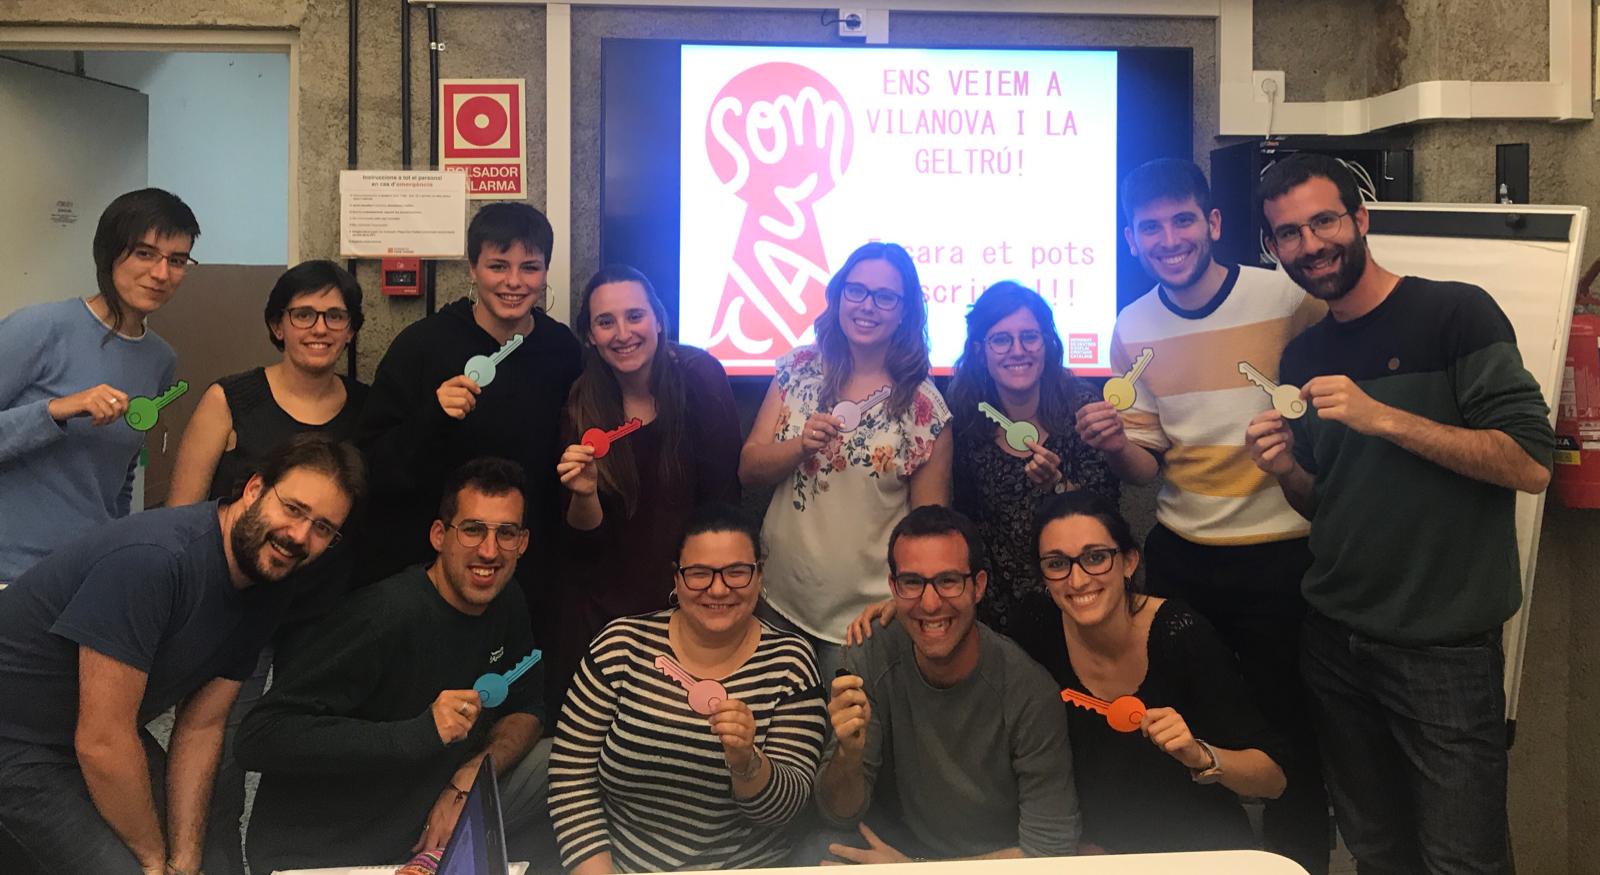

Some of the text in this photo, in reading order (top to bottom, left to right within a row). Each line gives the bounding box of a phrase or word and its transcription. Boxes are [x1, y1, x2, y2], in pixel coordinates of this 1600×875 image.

[883, 69, 1062, 96] ENS VEIEM A
[866, 109, 1078, 136] VILANOVA I LA
[915, 146, 1023, 176] GELTRÚ!
[982, 241, 1013, 265] et
[1031, 241, 1095, 269] pots
